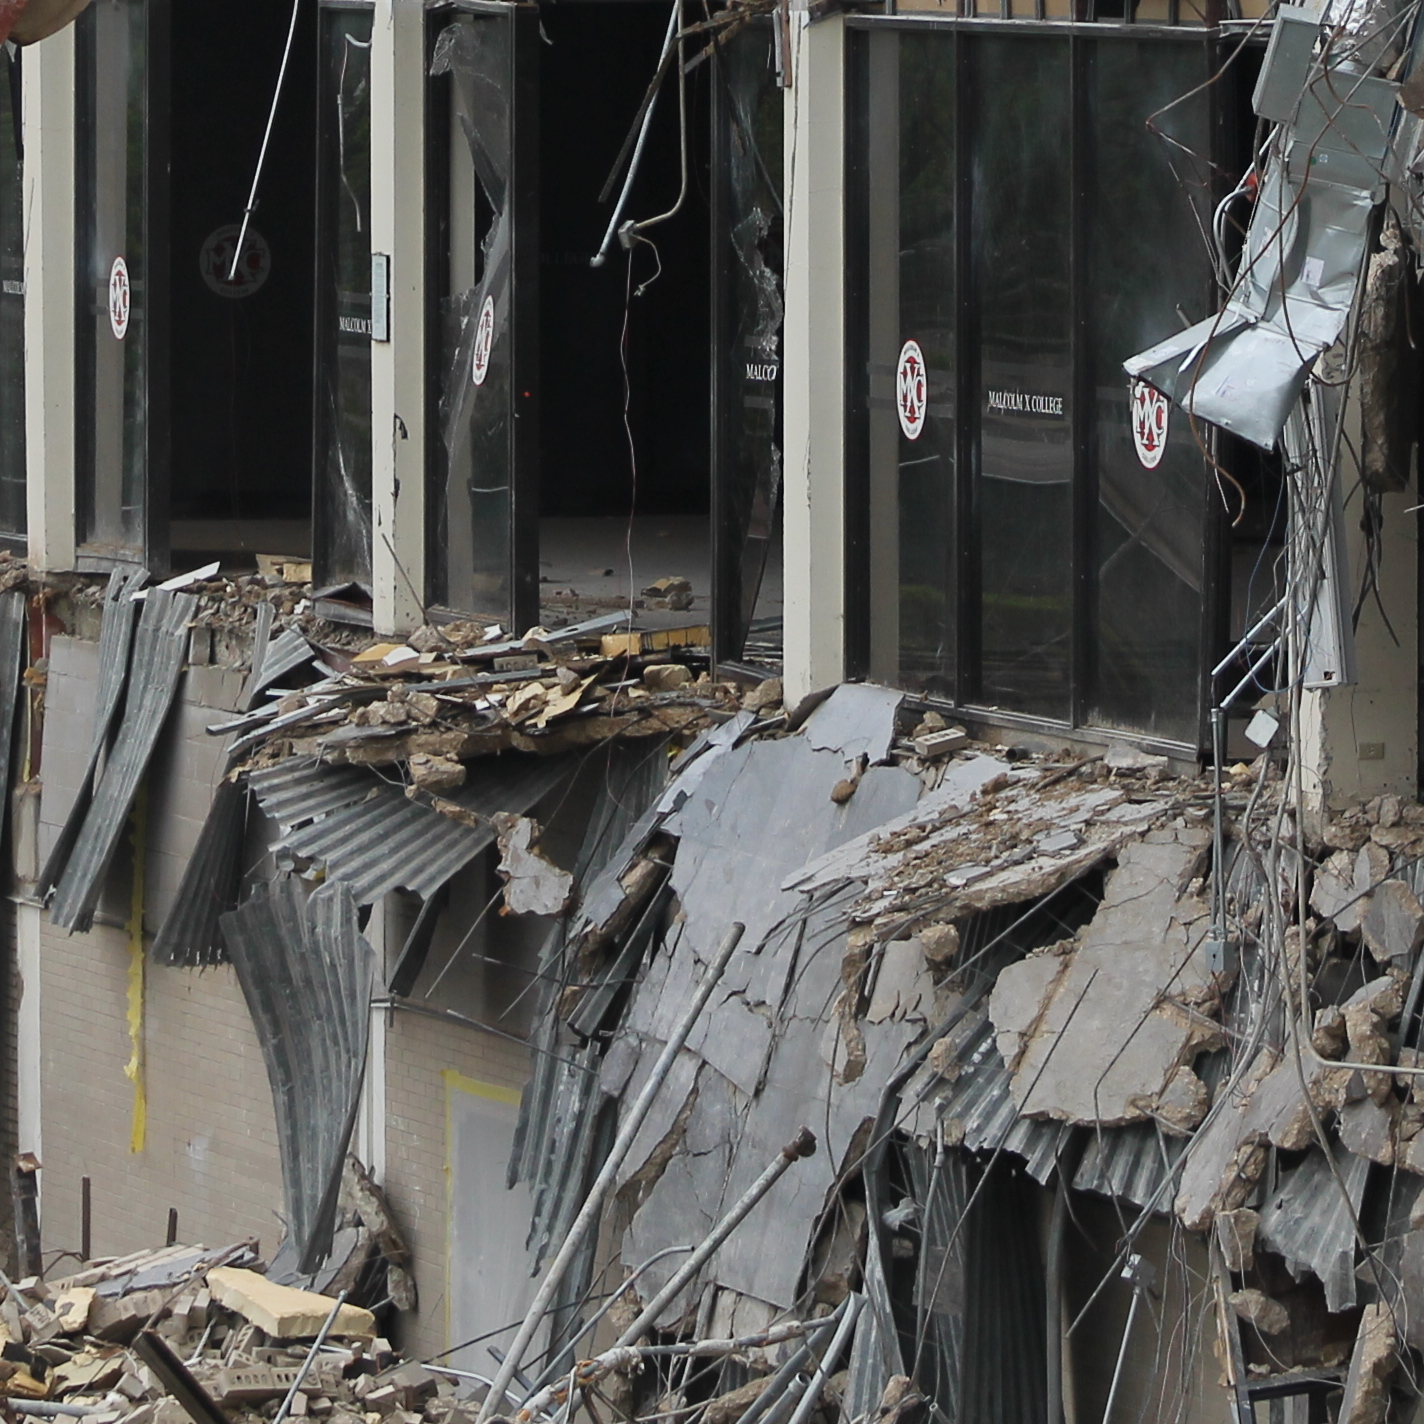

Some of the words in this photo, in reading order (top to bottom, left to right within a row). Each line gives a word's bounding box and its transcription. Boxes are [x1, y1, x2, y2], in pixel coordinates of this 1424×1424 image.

[339, 316, 366, 333] MALCOLM
[988, 390, 1023, 411] MALCOLM
[1023, 393, 1031, 412] X
[1031, 395, 1063, 415] COLLEGE
